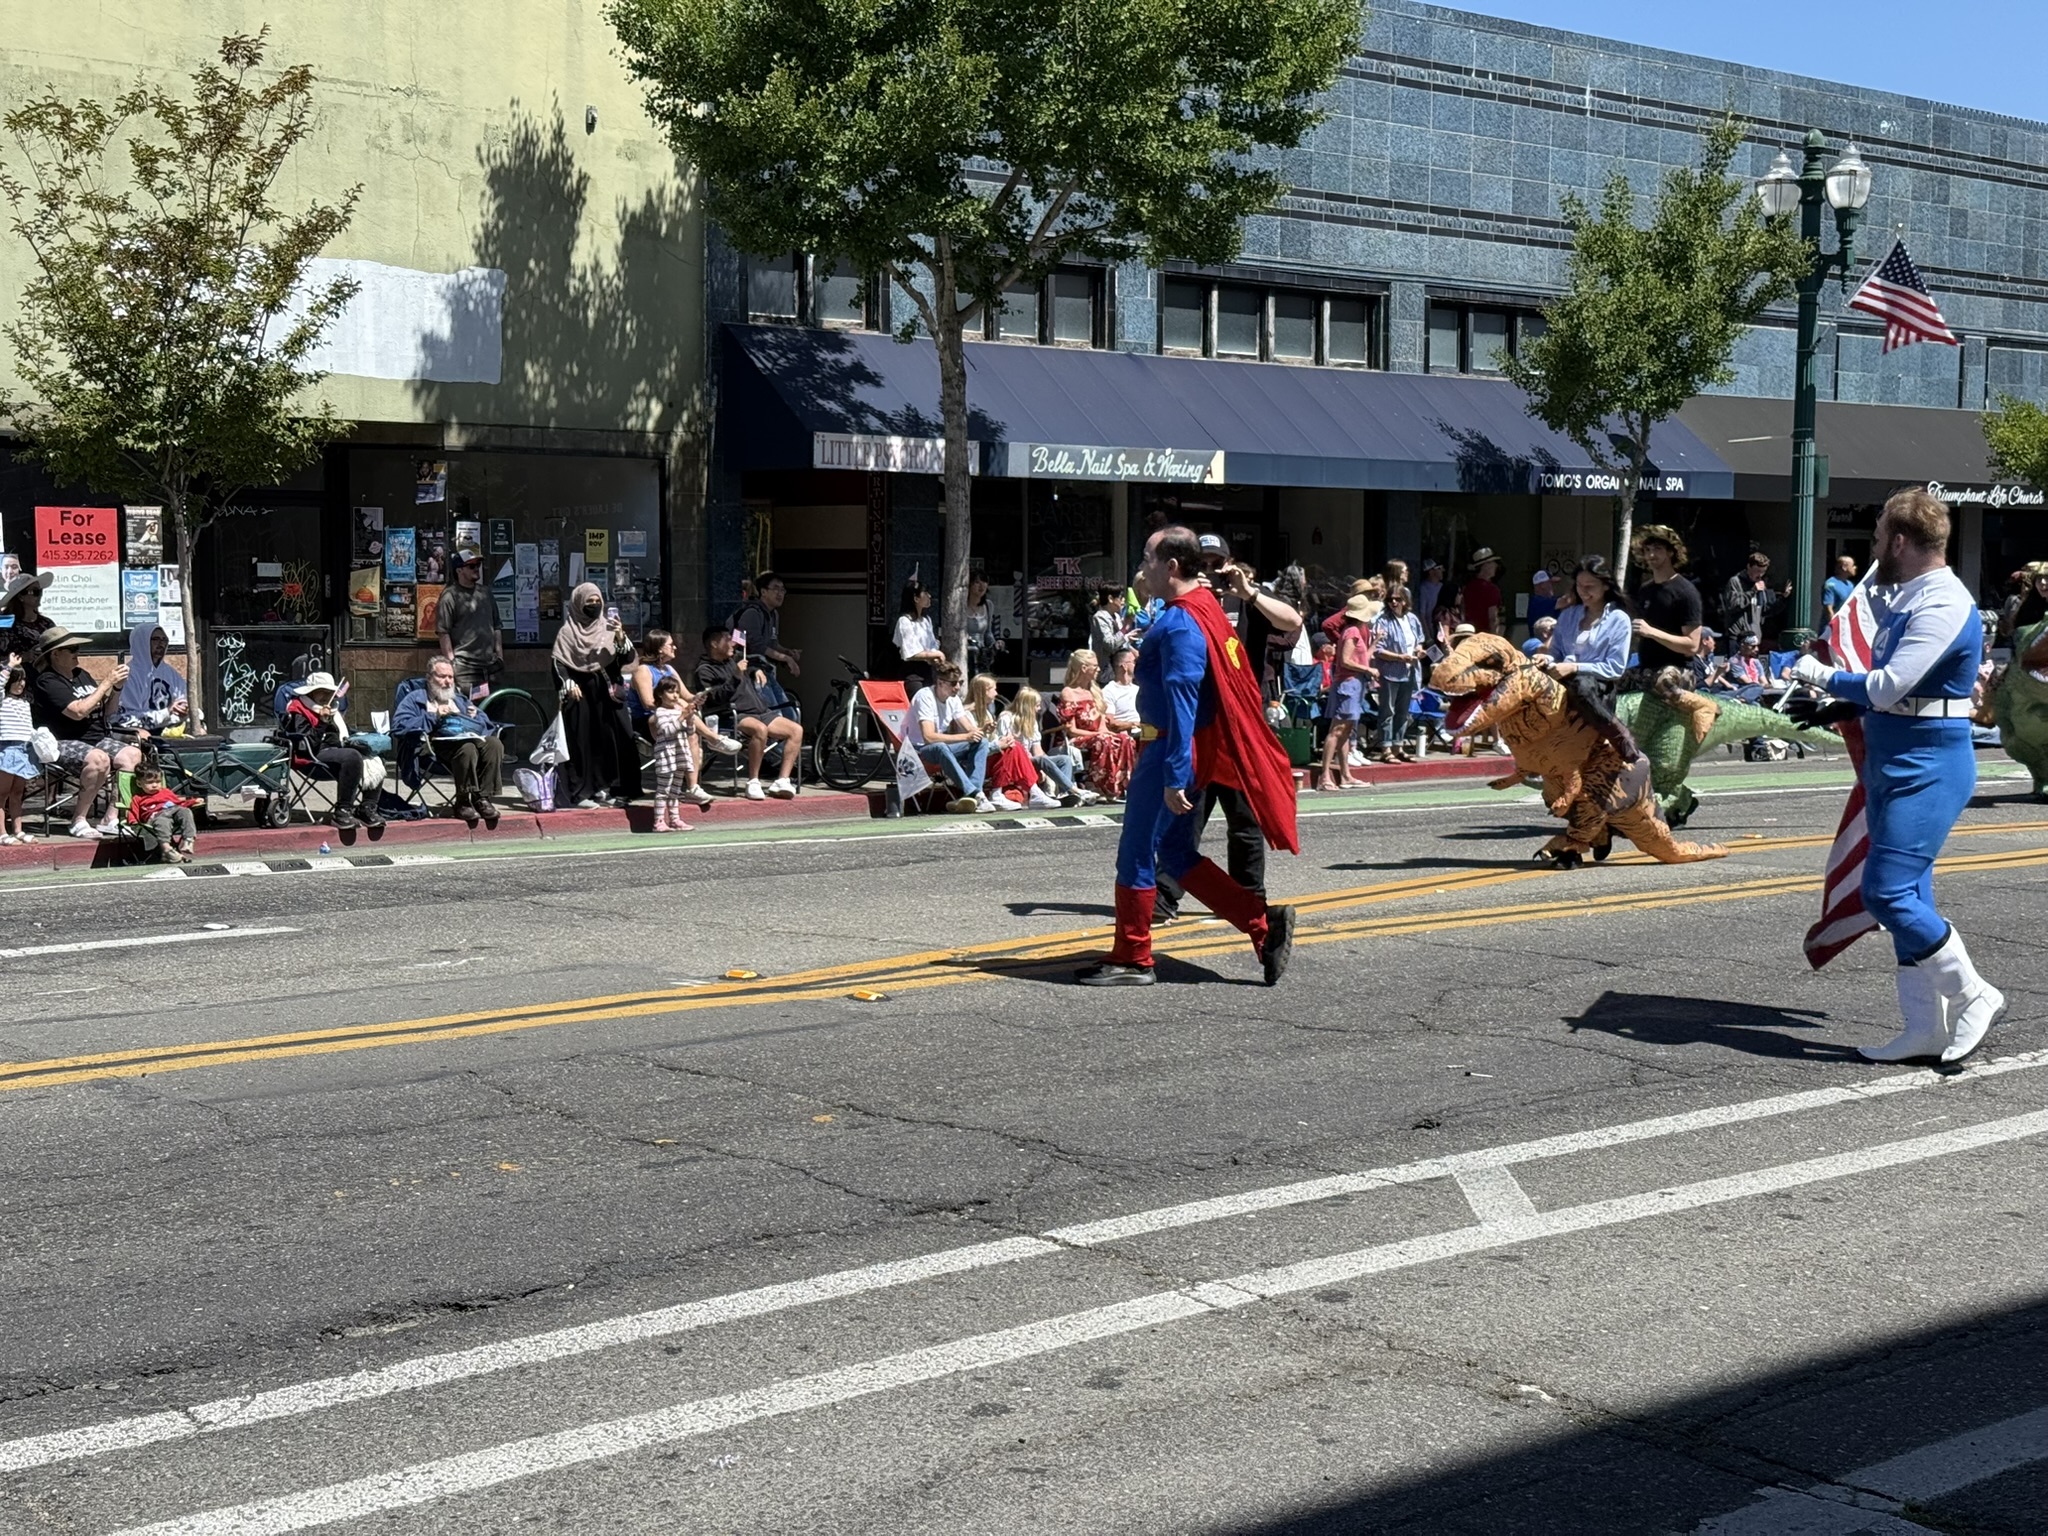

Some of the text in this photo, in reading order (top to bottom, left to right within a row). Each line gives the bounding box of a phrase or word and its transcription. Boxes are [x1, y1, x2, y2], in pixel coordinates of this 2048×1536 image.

[820, 439, 870, 467] LITTLE
[1032, 446, 1204, 482] Bella Nail Spa & Waxing
[1540, 473, 1582, 489] TOMO'S
[1639, 477, 1662, 491] NAIL
[1665, 477, 1684, 492] SPA
[1927, 481, 2044, 508] Triumphant Life Church
[60, 511, 94, 526] For
[48, 529, 106, 545] Lease
[589, 532, 605, 540] IMP
[42, 550, 114, 561] 415.395.7262
[1054, 557, 1082, 575] TK
[71, 574, 92, 583] Choi
[1065, 576, 1083, 590] SHOP
[42, 596, 109, 604] Jeff Badstubner
[105, 620, 118, 629] JLL
